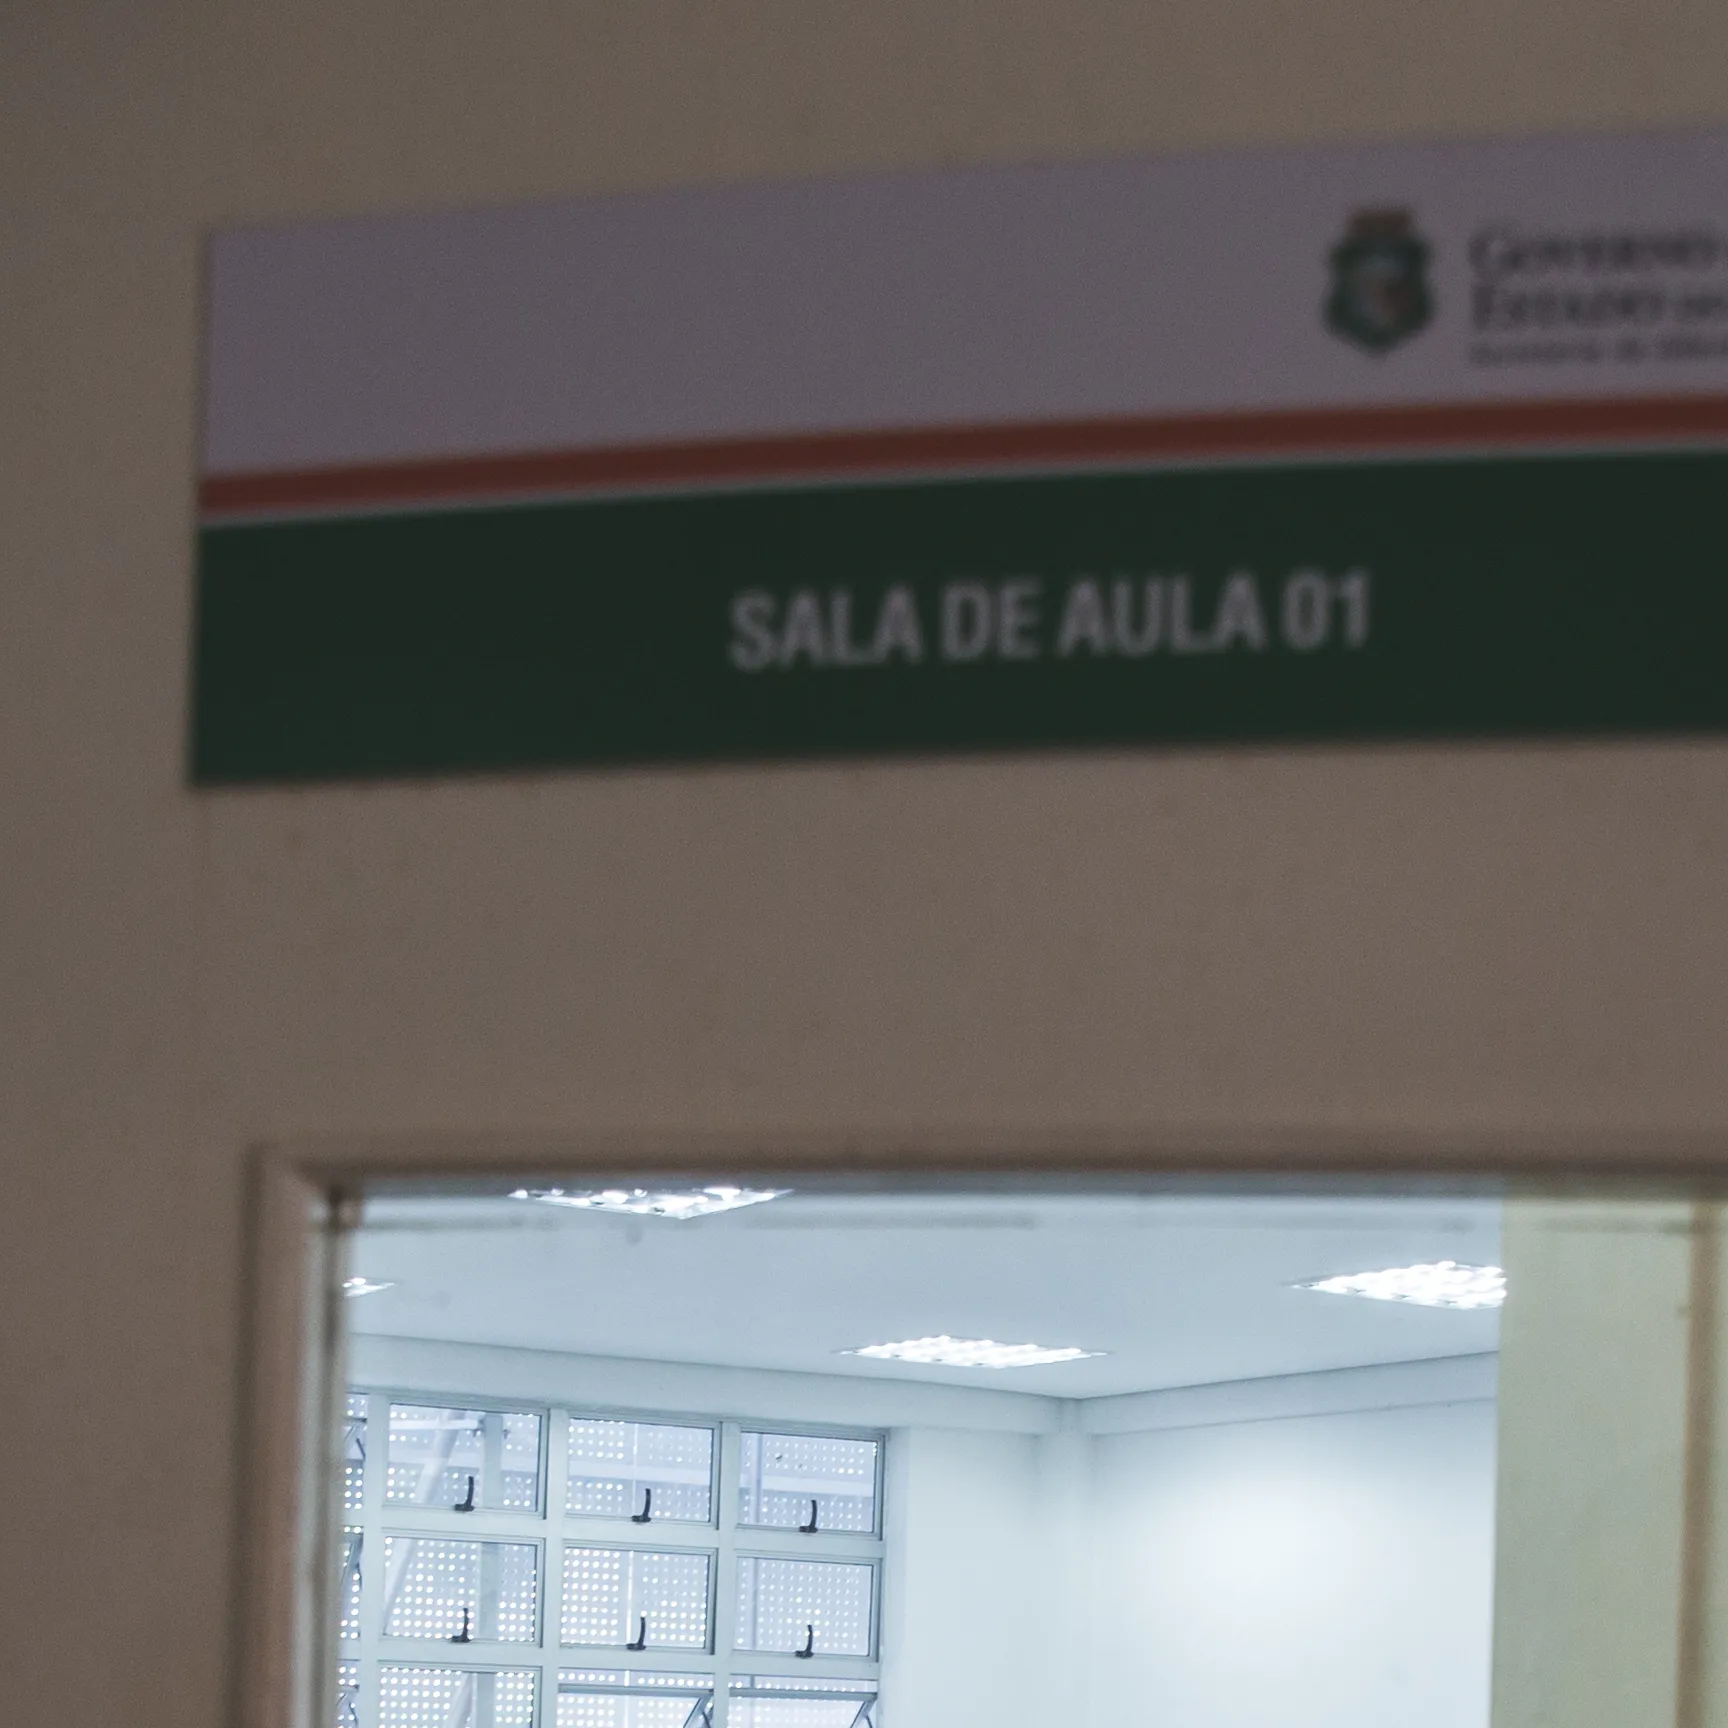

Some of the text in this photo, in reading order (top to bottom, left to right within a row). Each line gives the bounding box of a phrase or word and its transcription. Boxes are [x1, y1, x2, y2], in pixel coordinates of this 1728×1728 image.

[728, 568, 1369, 670] SALA DE AULA 01
